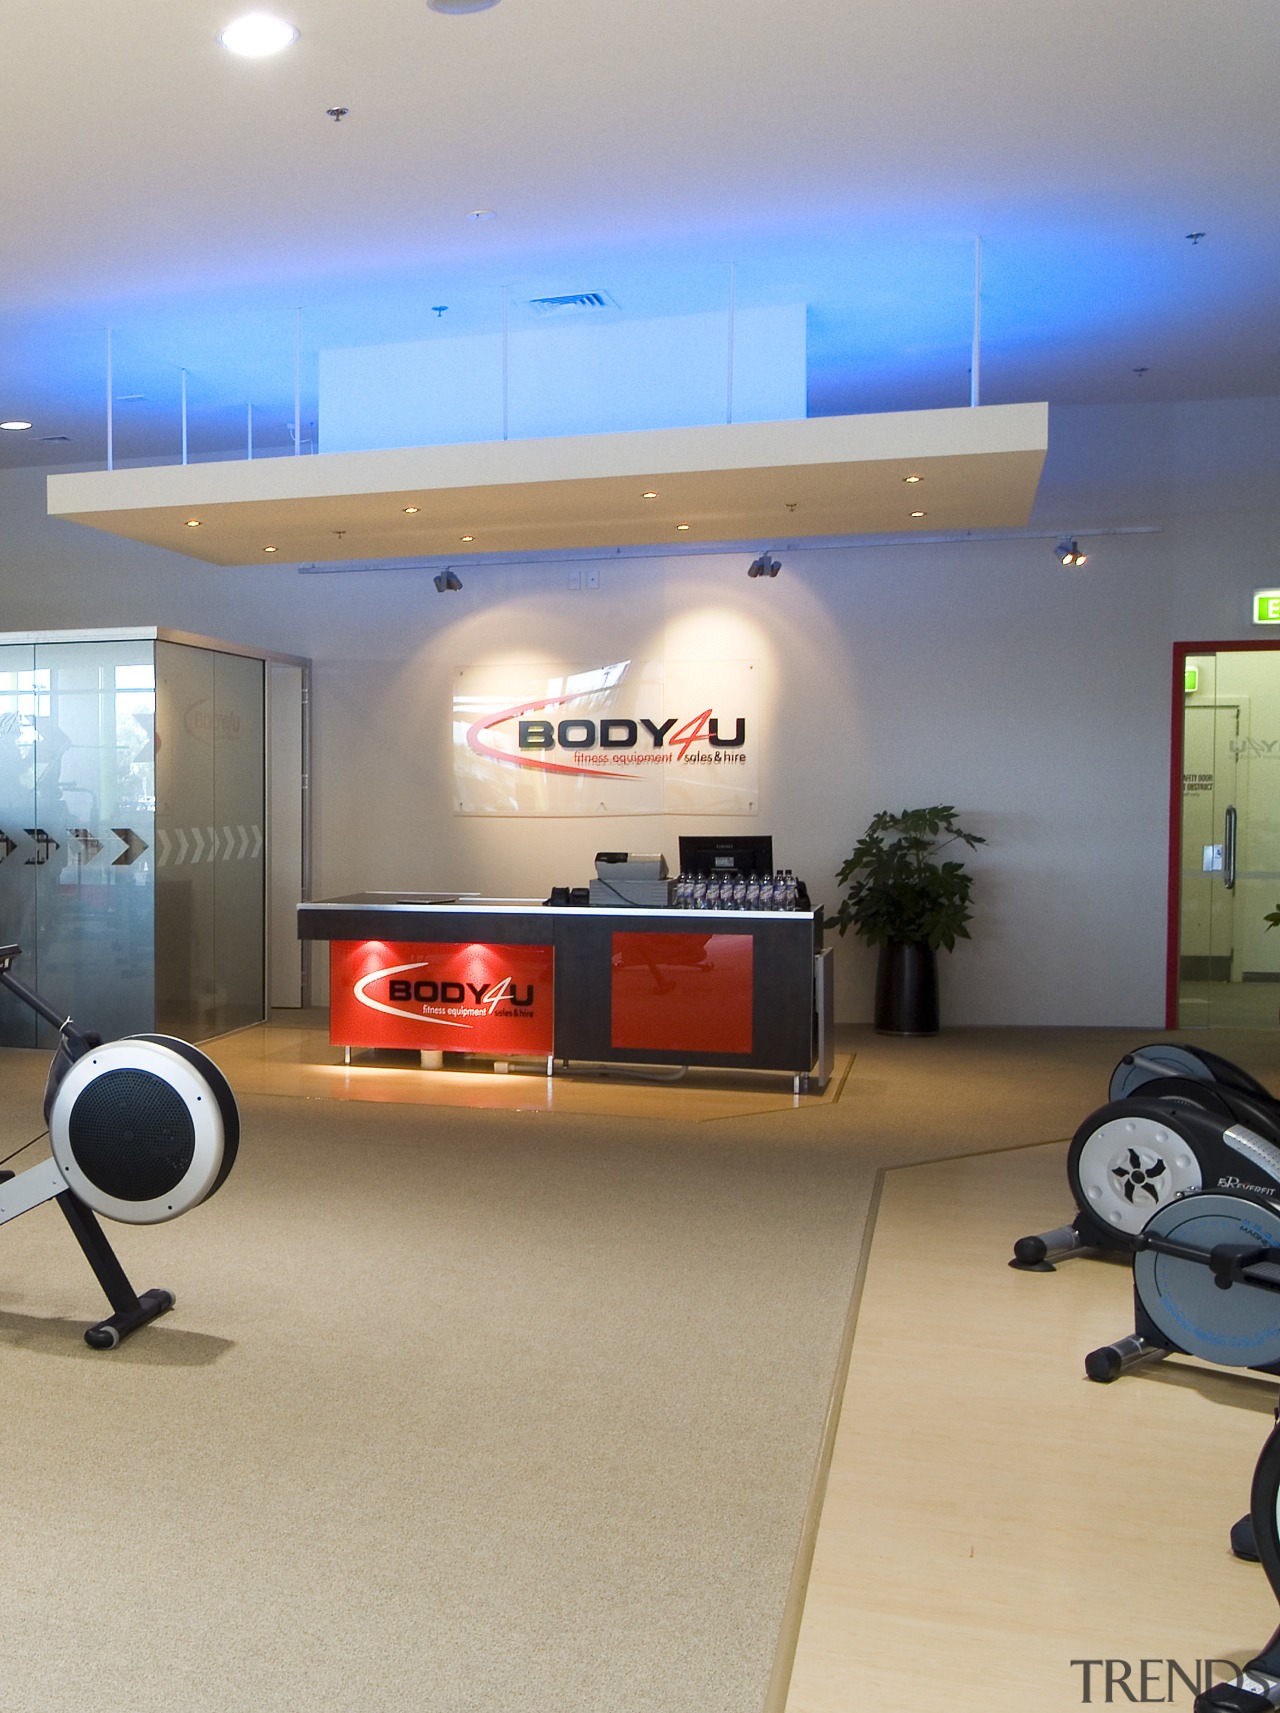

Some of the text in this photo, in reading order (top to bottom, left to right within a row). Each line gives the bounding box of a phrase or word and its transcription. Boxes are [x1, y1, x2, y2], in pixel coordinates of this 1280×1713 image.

[518, 709, 746, 761] BODY4U
[574, 751, 609, 764] fitness
[613, 752, 673, 767] equipment
[389, 977, 534, 1015] BODY4U
[422, 1004, 446, 1015] fitness
[447, 1005, 487, 1018] equipment
